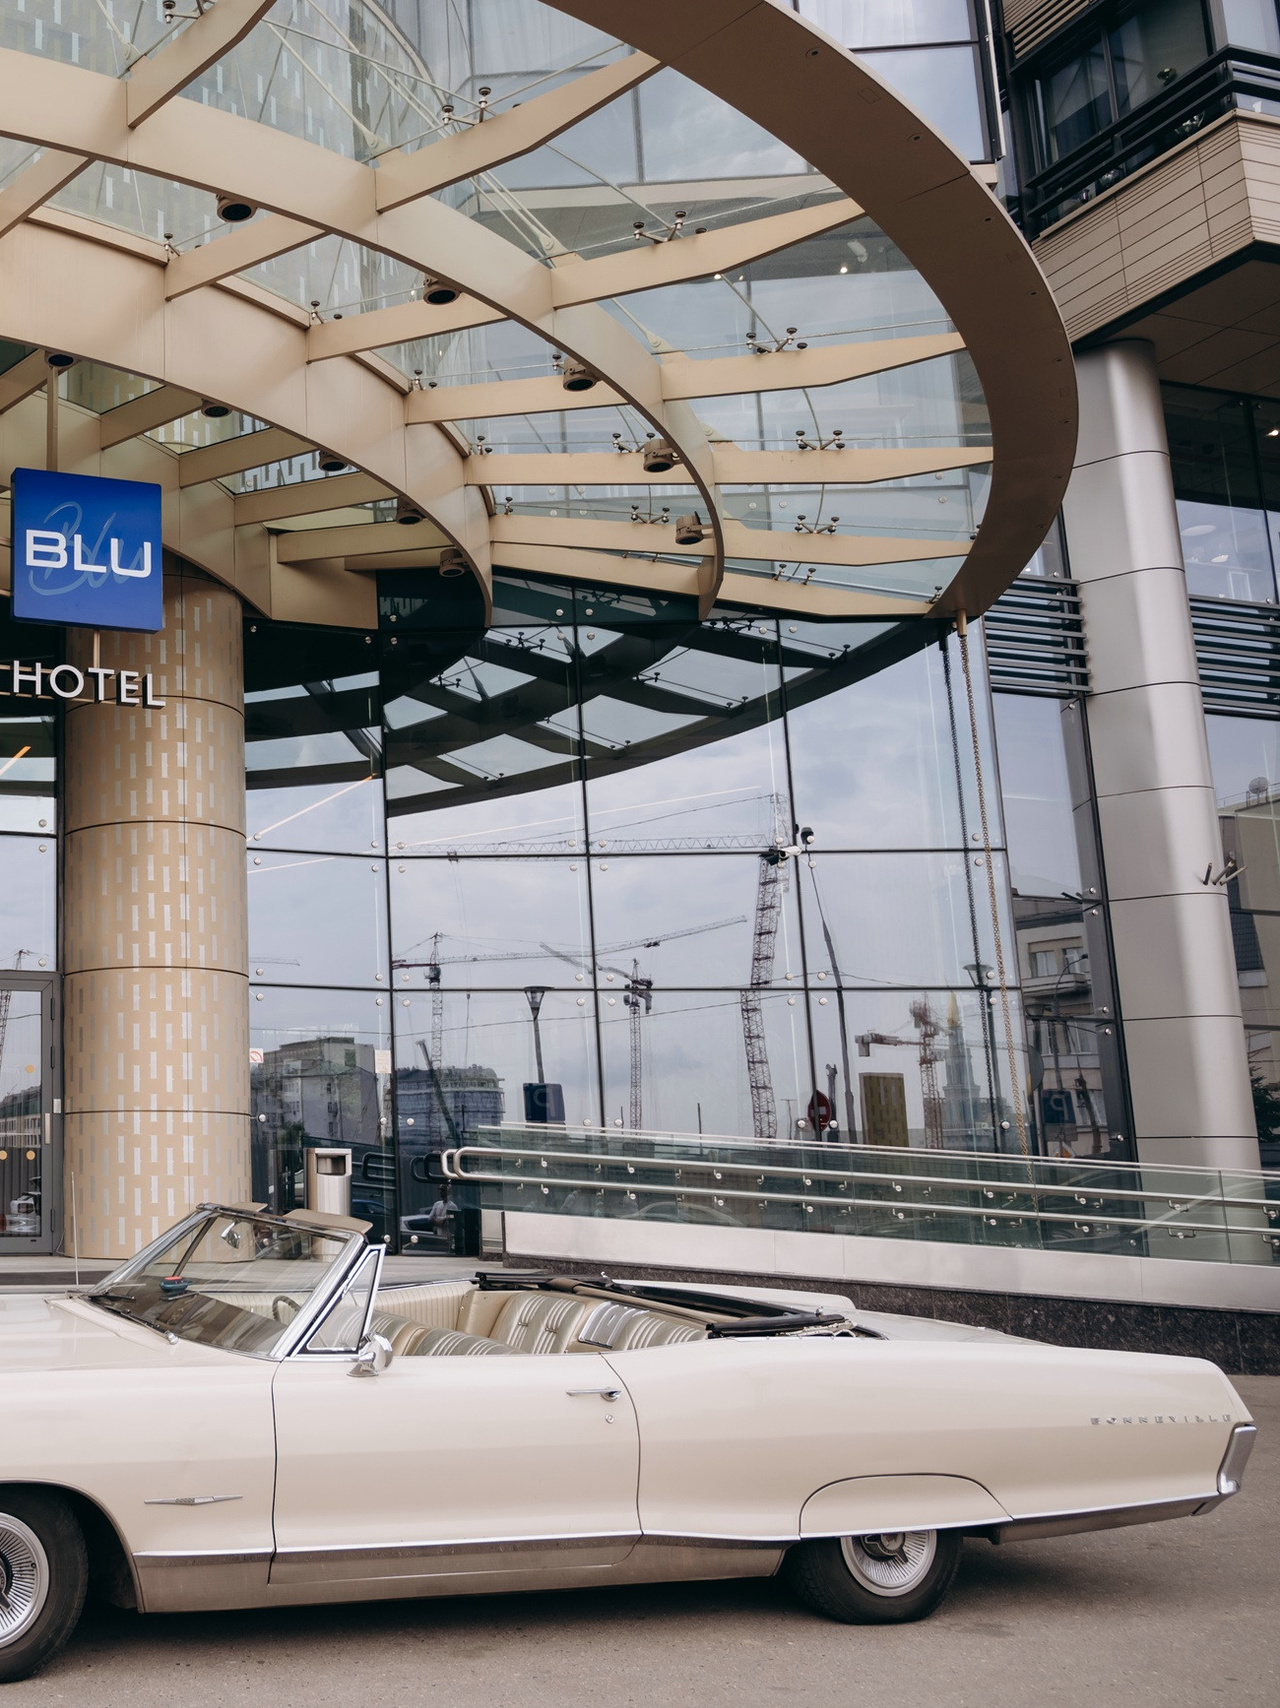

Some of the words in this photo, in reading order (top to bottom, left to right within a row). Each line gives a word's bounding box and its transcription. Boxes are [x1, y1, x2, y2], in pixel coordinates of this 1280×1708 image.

[25, 528, 152, 579] BLU
[12, 660, 166, 710] HOTEL
[1090, 1413, 1232, 1425] BONNEVILLE
